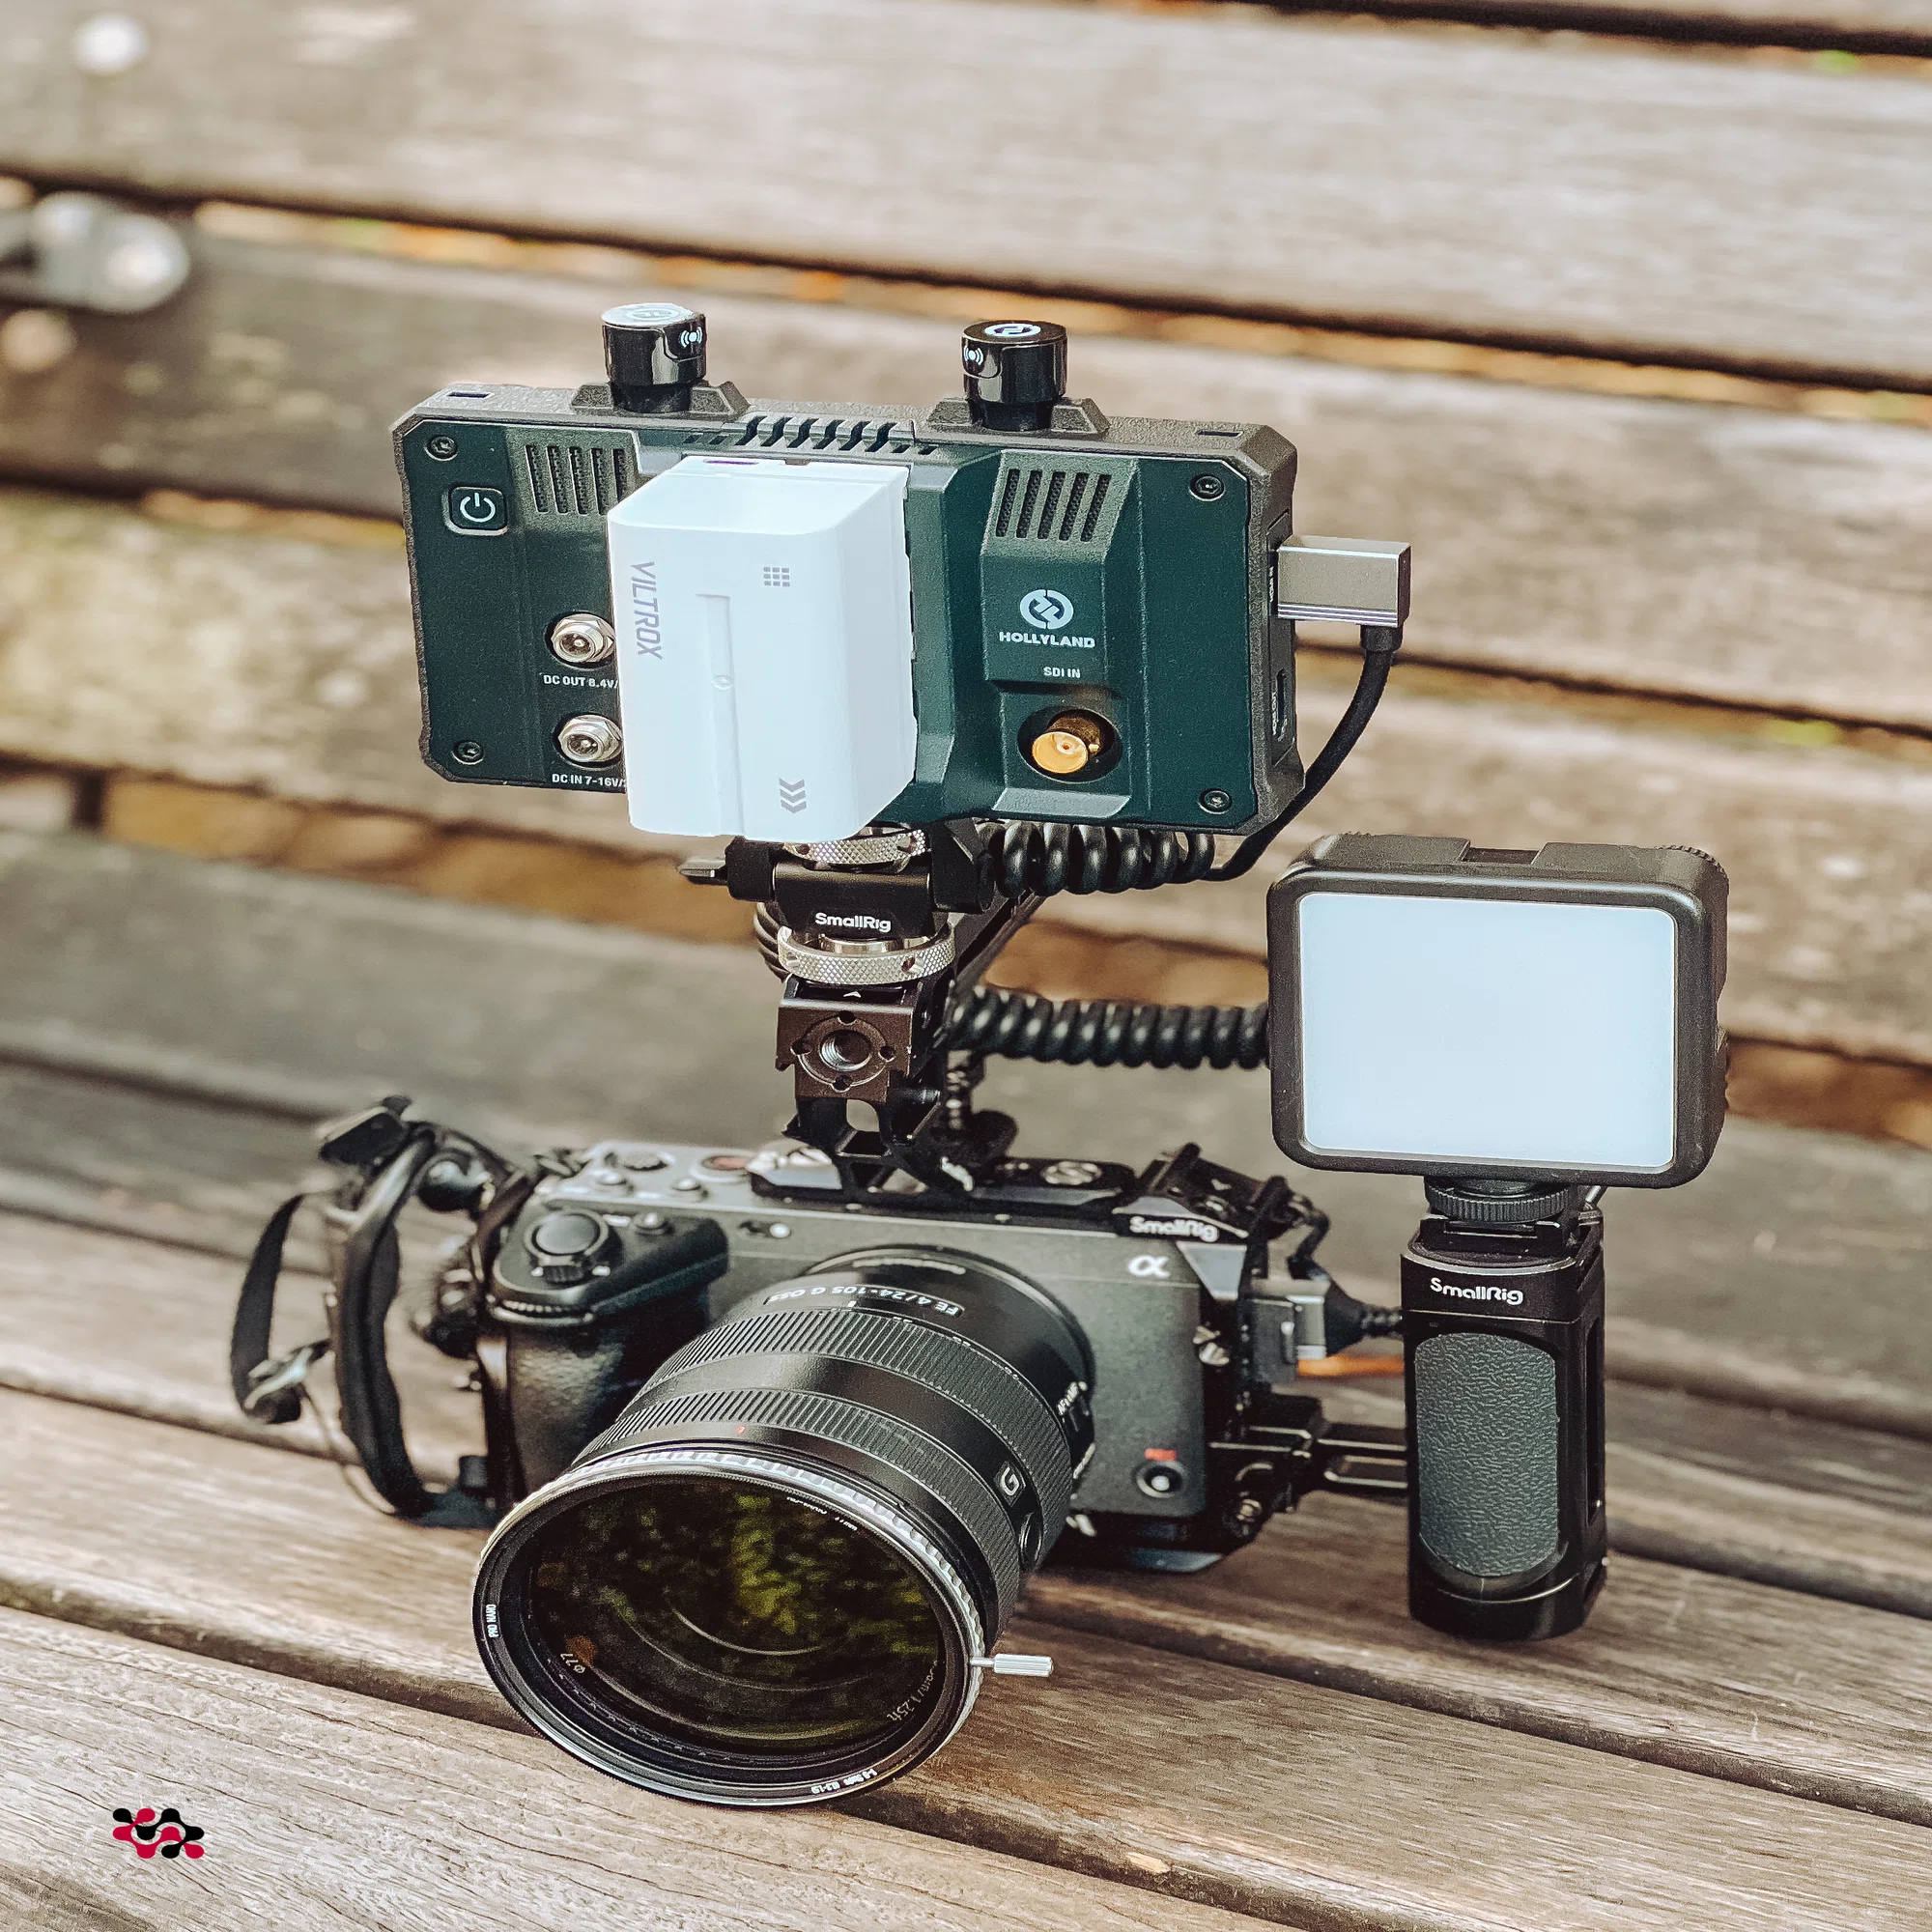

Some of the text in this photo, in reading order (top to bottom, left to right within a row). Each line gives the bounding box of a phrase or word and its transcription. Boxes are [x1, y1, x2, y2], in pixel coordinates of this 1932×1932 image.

[631, 561, 664, 661] VILTROX
[999, 631, 1096, 649] HOLLYLAND
[542, 674, 560, 685] DC
[562, 675, 586, 687] OUT
[1043, 666, 1082, 679] SDI IN
[552, 773, 568, 783] DC
[570, 774, 582, 784] IN
[814, 912, 893, 933] SmallRig
[1129, 1215, 1219, 1243] SmallRig
[810, 1286, 827, 1295] G
[831, 1285, 932, 1306] 4/24-105
[1430, 1277, 1524, 1306] SmallRig
[933, 1299, 959, 1317] FE
[999, 1465, 1020, 1496] G
